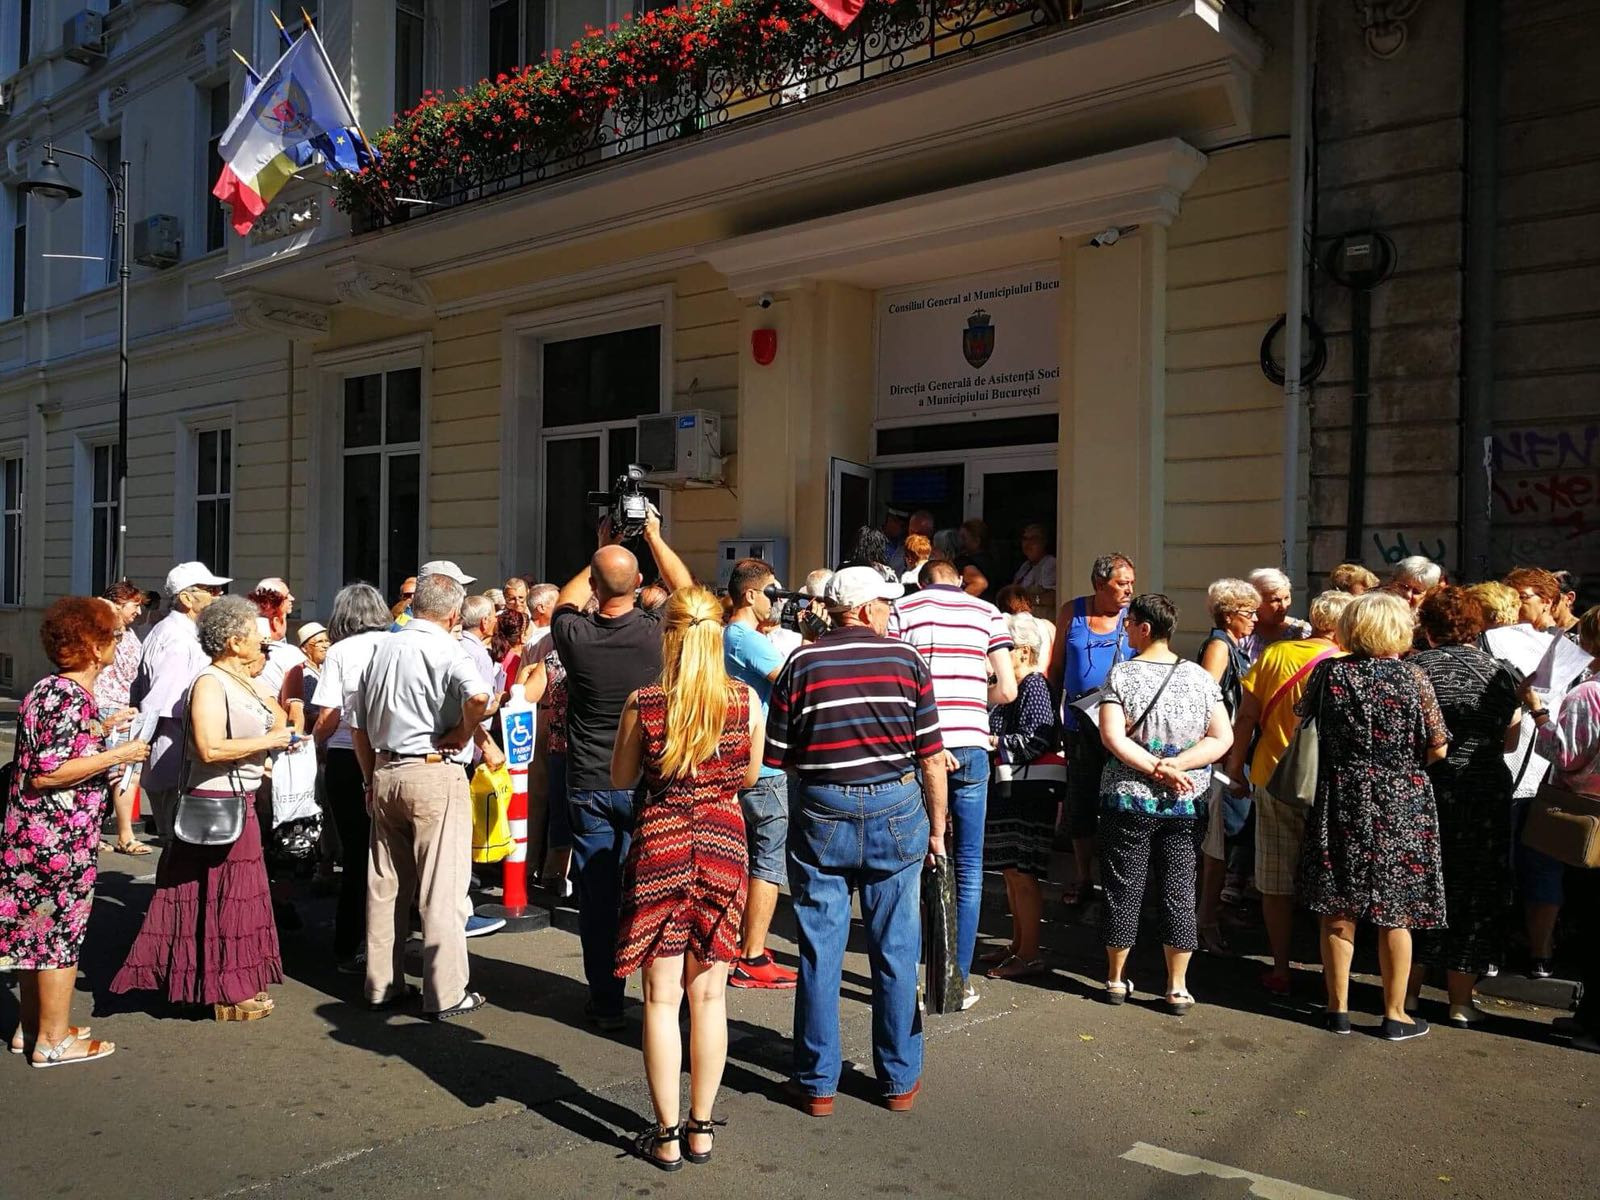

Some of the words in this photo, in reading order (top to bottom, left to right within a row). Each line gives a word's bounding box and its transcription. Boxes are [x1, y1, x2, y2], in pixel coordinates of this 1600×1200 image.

[888, 300, 925, 314] Consiliul
[927, 294, 961, 308] General
[963, 294, 971, 303] al
[974, 282, 1032, 299] Municipiului
[928, 376, 972, 392] Generală
[974, 375, 986, 387] de
[918, 398, 924, 406] a
[926, 389, 989, 407] Municipiului
